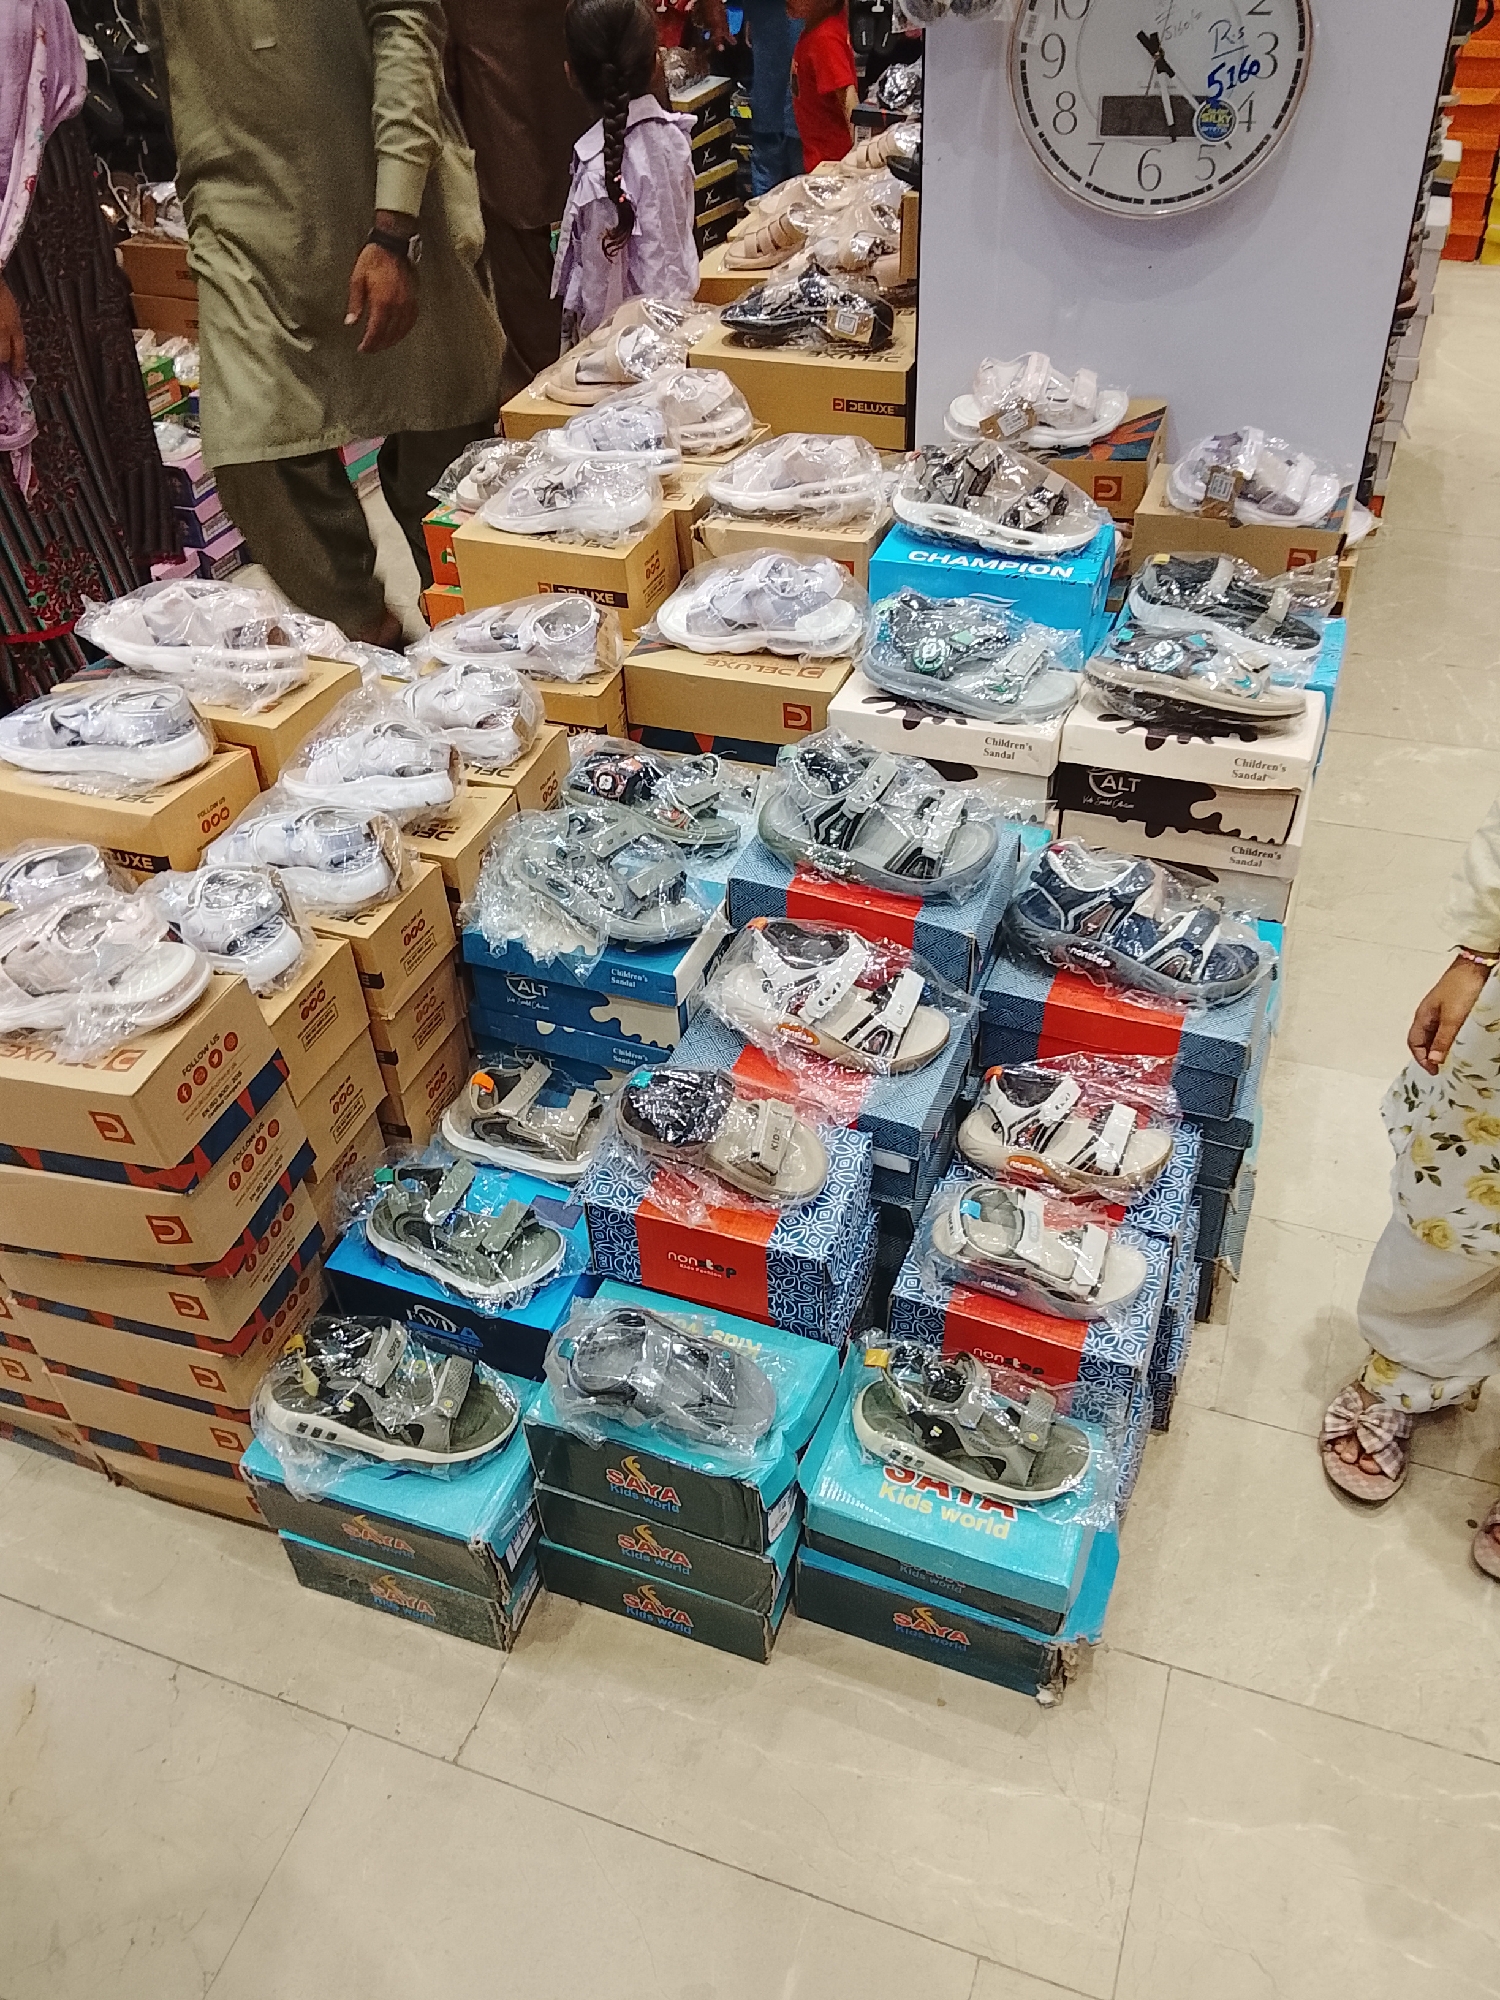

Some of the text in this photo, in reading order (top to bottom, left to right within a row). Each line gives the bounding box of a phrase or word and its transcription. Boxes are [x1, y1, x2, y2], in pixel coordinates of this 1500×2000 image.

[1041, 33, 1066, 78] 9
[1257, 31, 1278, 79] 3
[1207, 54, 1261, 104] 5160
[1052, 91, 1078, 135] 8
[1237, 90, 1257, 132] 4
[1088, 142, 1105, 176] 7
[1137, 148, 1162, 192] 6
[1194, 144, 1216, 181] 5
[849, 401, 895, 415] DELUXE
[908, 551, 1074, 578] CHAMPION
[703, 658, 795, 676] DELUXE
[983, 748, 1016, 761] Sandal
[984, 736, 1033, 752] Children's
[1232, 769, 1267, 781] Sandal
[1234, 757, 1287, 772] Children's
[1229, 857, 1262, 867] Sandal
[1231, 845, 1282, 860] Children's
[611, 968, 648, 983] Children's
[611, 976, 636, 988] Sandal
[182, 1033, 221, 1076] FOLLOW US
[613, 1047, 649, 1062] Children's
[668, 1252, 737, 1278] nonstop
[606, 1466, 681, 1507] SAYA
[609, 1483, 680, 1514] Kids world
[879, 1481, 1012, 1540] Kids world
[617, 1531, 692, 1569] SAYA
[621, 1547, 690, 1576] Kids world
[623, 1591, 694, 1627] SAYA
[626, 1606, 692, 1635] Kids world
[893, 1611, 971, 1646] SAYA
